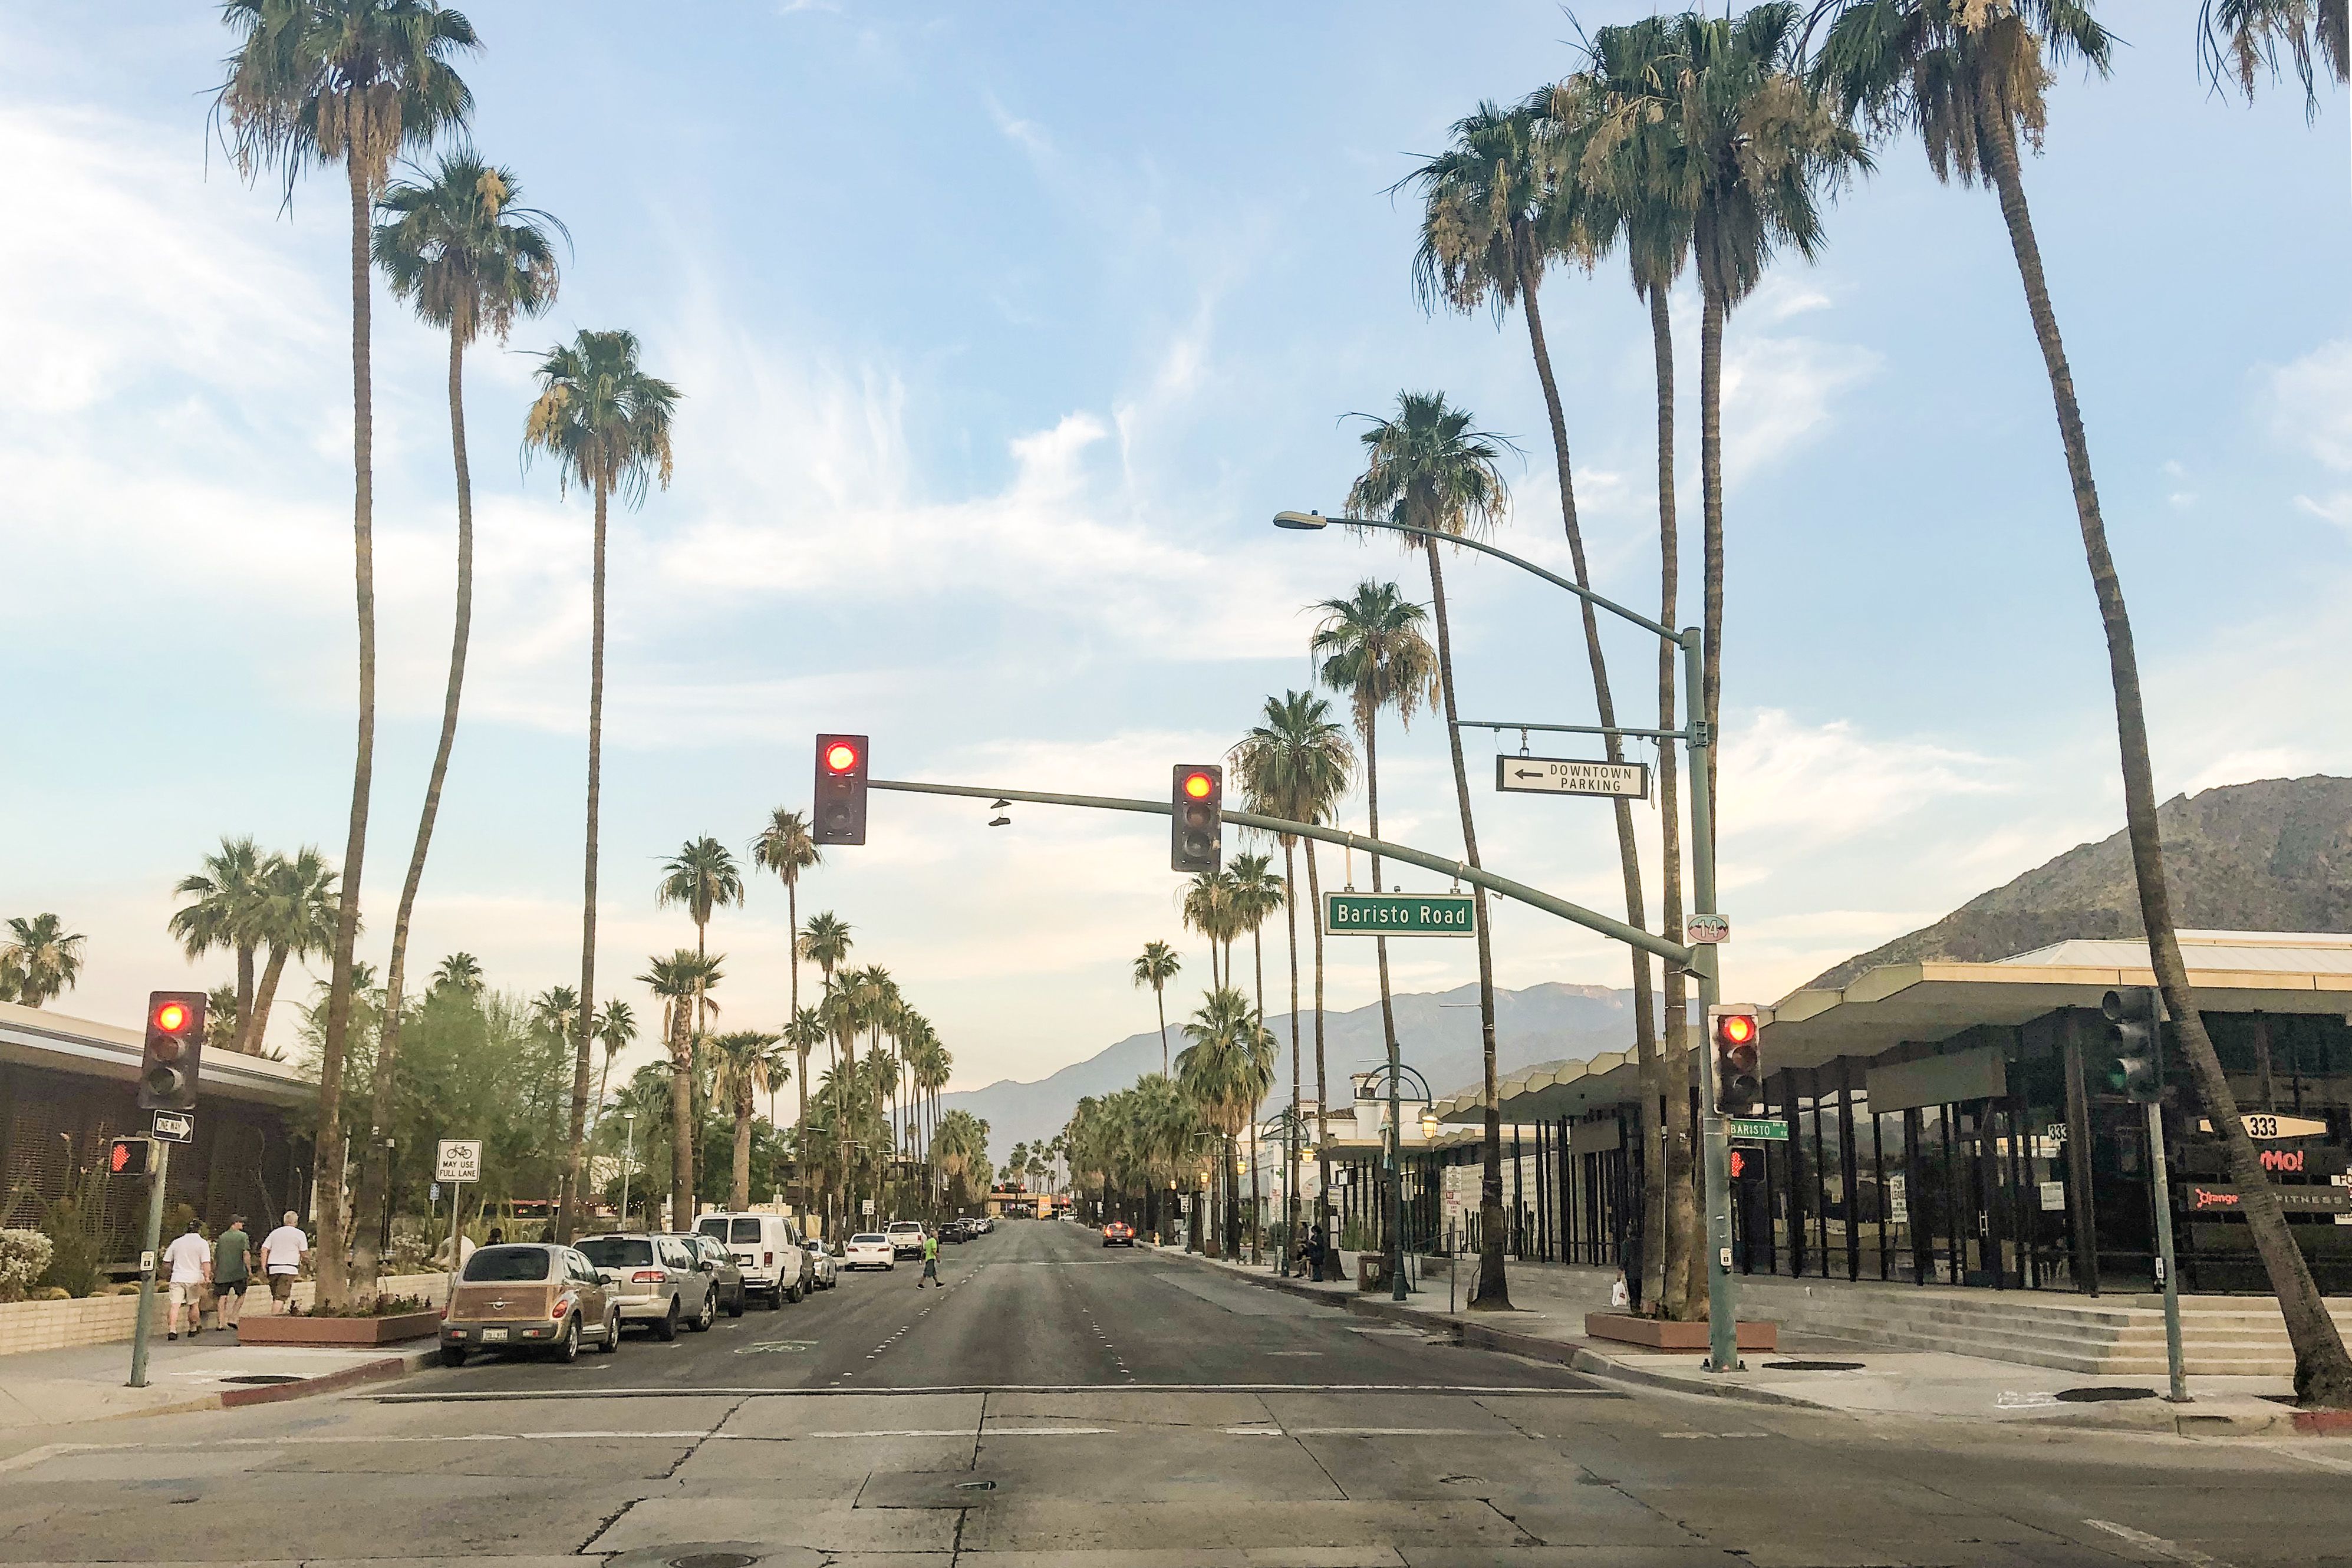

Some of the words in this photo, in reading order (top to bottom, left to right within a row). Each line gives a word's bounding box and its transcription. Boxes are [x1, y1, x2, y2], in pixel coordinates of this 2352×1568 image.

[1550, 765, 1631, 779] DOWNTOWN
[1561, 778, 1620, 792] PARKING
[1338, 904, 1409, 924] Baristo
[1420, 906, 1465, 924] Road
[1698, 920, 1719, 938] 14
[158, 1119, 169, 1131] ONE
[170, 1121, 182, 1132] WAY
[1730, 1124, 1770, 1135] BARISTO
[2050, 1125, 2067, 1140] 333
[2249, 1117, 2278, 1137] 333
[2275, 1195, 2343, 1204] FITNESS
